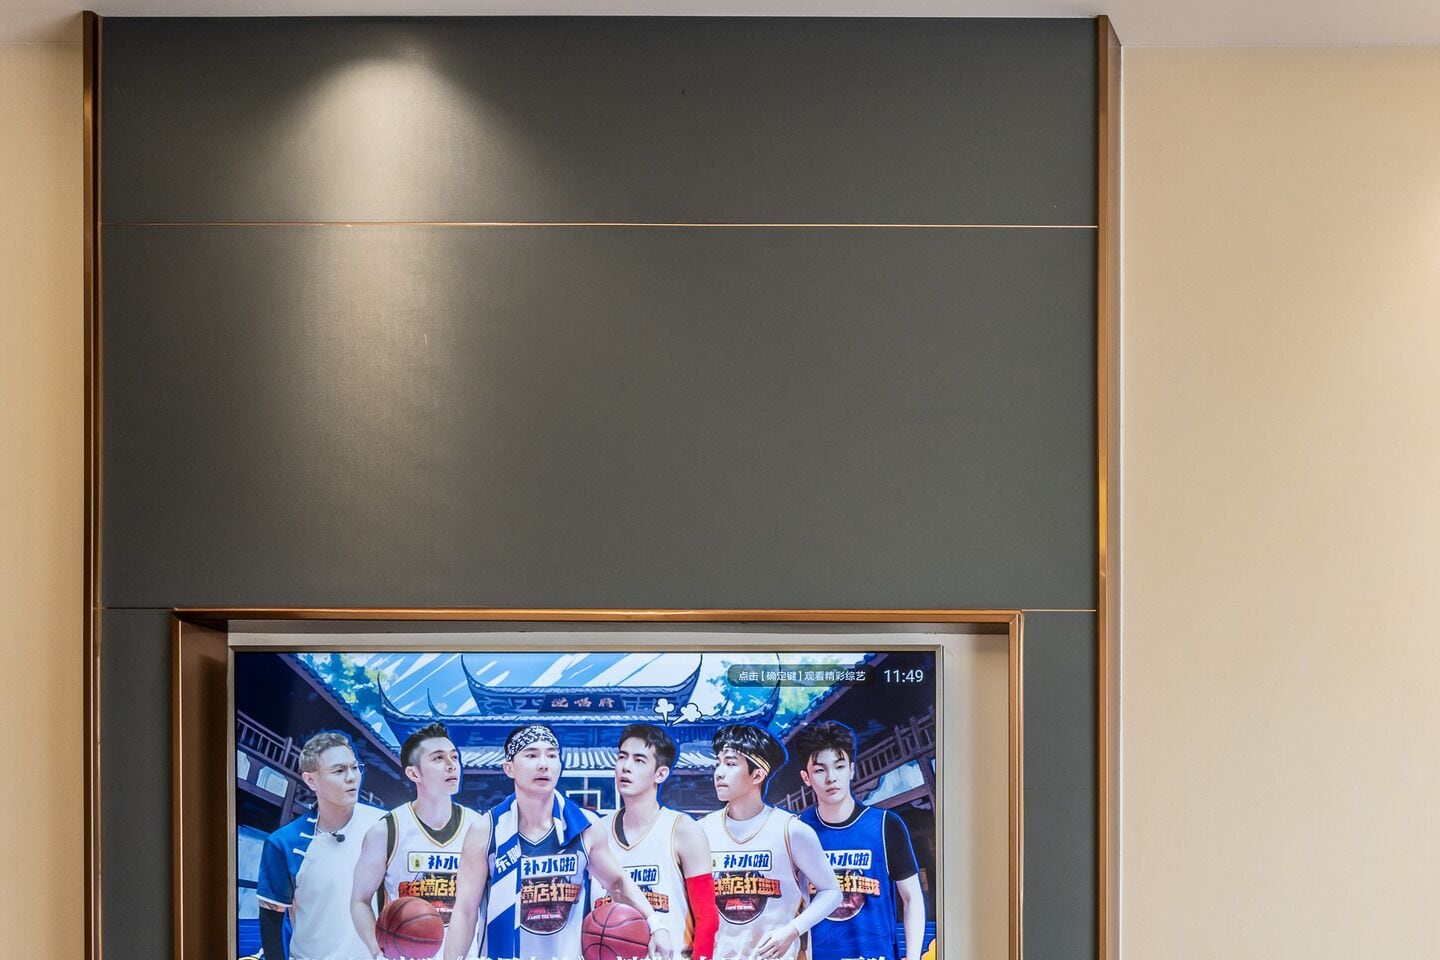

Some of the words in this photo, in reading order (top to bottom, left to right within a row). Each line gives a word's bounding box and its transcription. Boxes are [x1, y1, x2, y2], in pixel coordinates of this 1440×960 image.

[884, 670, 924, 683] 11:49
[523, 856, 576, 876] 补水啦
[723, 853, 770, 868] 补水啦
